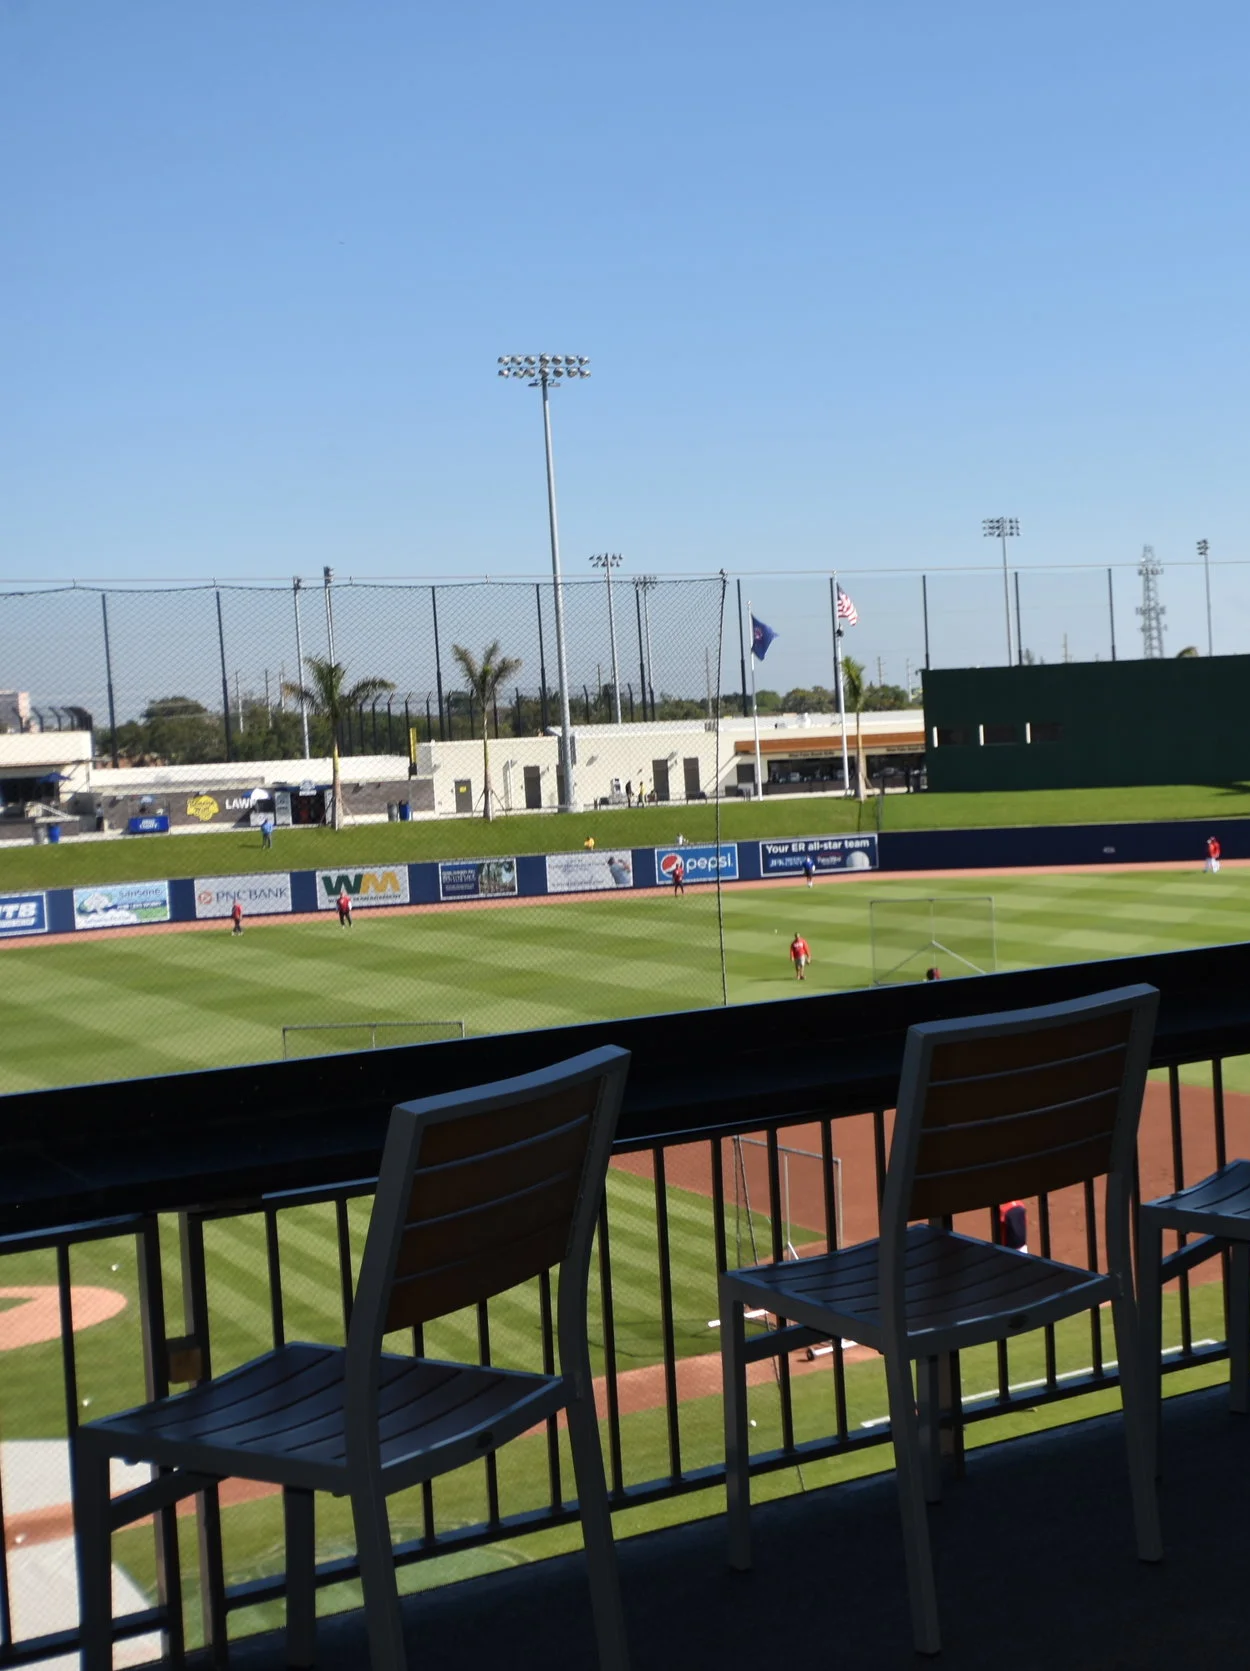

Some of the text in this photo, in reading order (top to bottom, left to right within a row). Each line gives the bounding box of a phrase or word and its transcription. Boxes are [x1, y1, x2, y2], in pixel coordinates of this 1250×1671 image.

[766, 839, 870, 854] Your ER all-star team
[686, 852, 732, 872] pepsi
[321, 871, 400, 897] WM
[216, 887, 288, 901] PNC BANK
